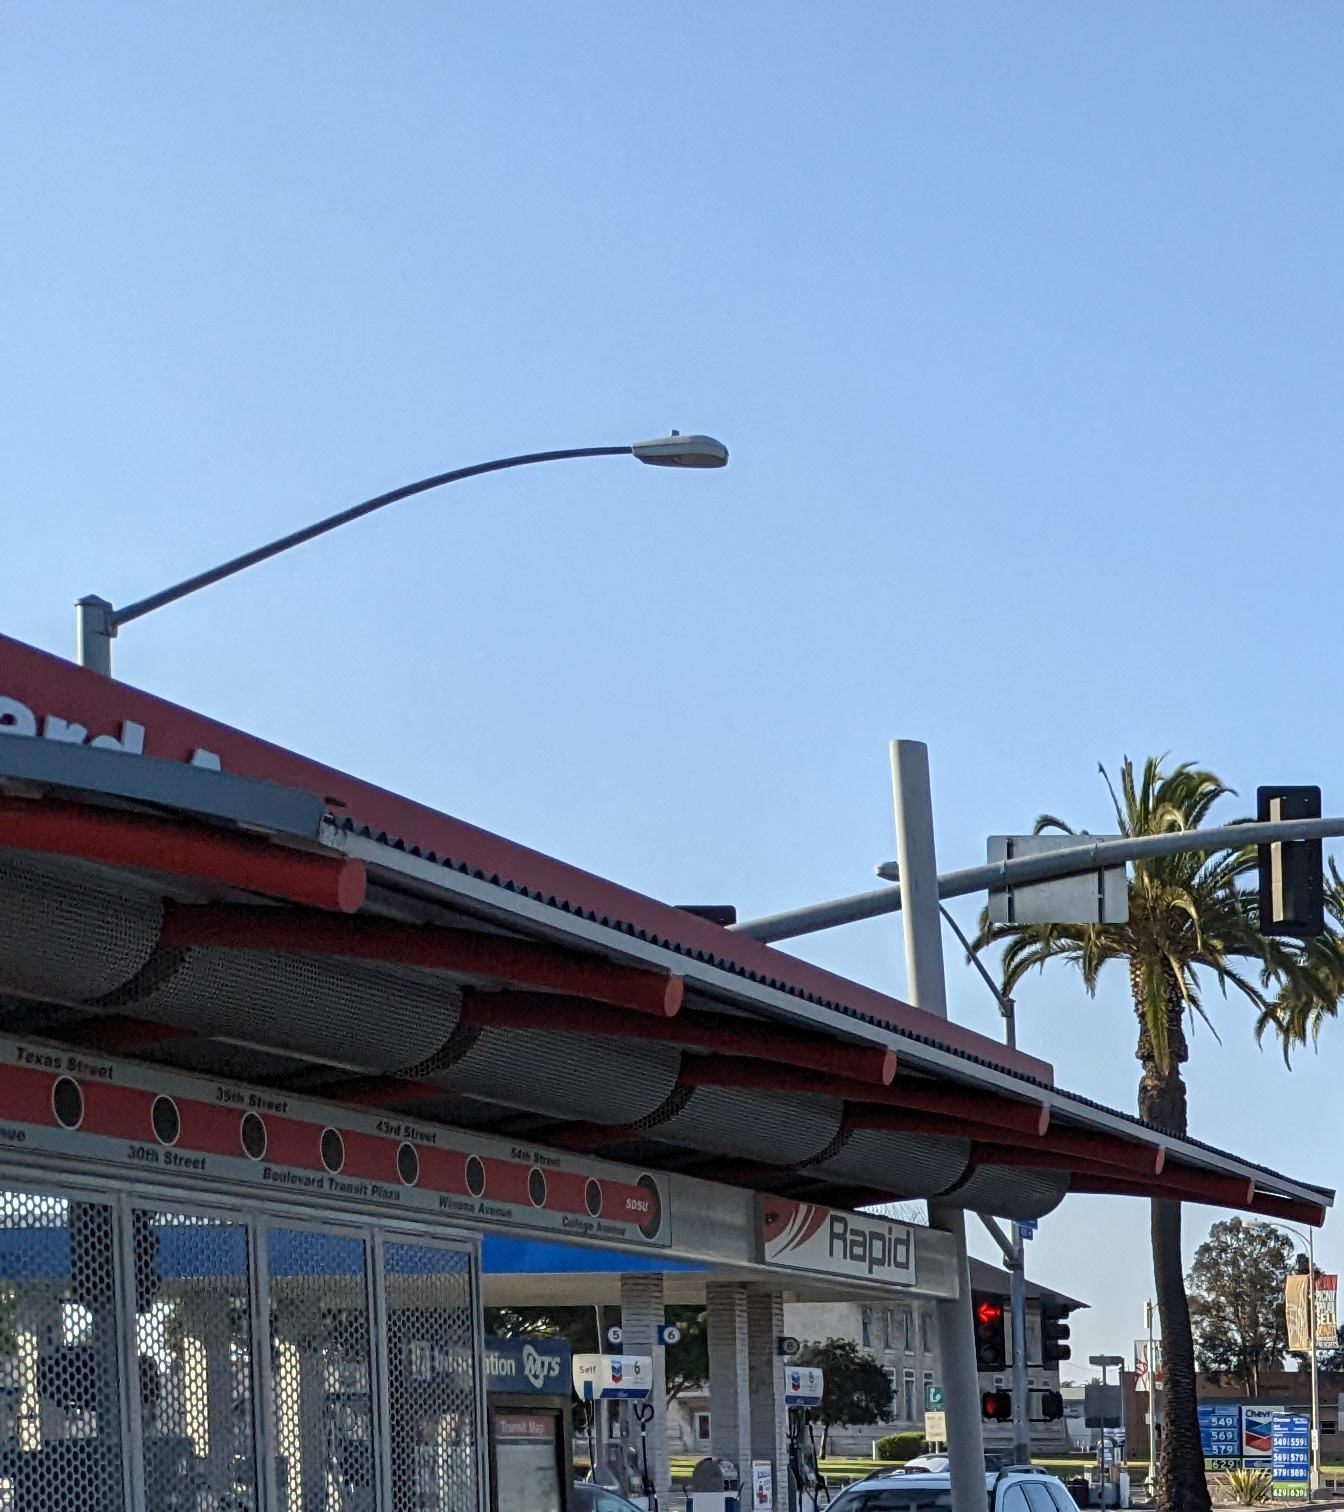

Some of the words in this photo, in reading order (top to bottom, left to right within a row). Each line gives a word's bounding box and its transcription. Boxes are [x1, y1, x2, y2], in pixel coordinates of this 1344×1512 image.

[16, 1046, 62, 1069] Texas
[66, 1056, 114, 1081] Street
[248, 1094, 288, 1113] Street
[375, 1120, 401, 1136] 43rd
[403, 1123, 437, 1144] Street
[127, 1144, 159, 1163] 30th
[163, 1152, 207, 1171] Street
[533, 1151, 561, 1168] Street
[262, 1166, 325, 1190] Boulevard
[327, 1177, 368, 1197] Transit
[371, 1183, 401, 1201] Plaza
[478, 1202, 513, 1219] Avenue
[625, 1197, 649, 1213] SDSU
[829, 1214, 911, 1275] Rapid
[523, 1354, 561, 1378] MTS
[579, 1365, 597, 1374] Self
[633, 1361, 641, 1376] 6
[1211, 1418, 1233, 1426] 549
[1245, 1410, 1272, 1418] Chevr
[1211, 1432, 1233, 1440] 569
[1211, 1445, 1233, 1455] 579
[1212, 1460, 1235, 1469] 629
